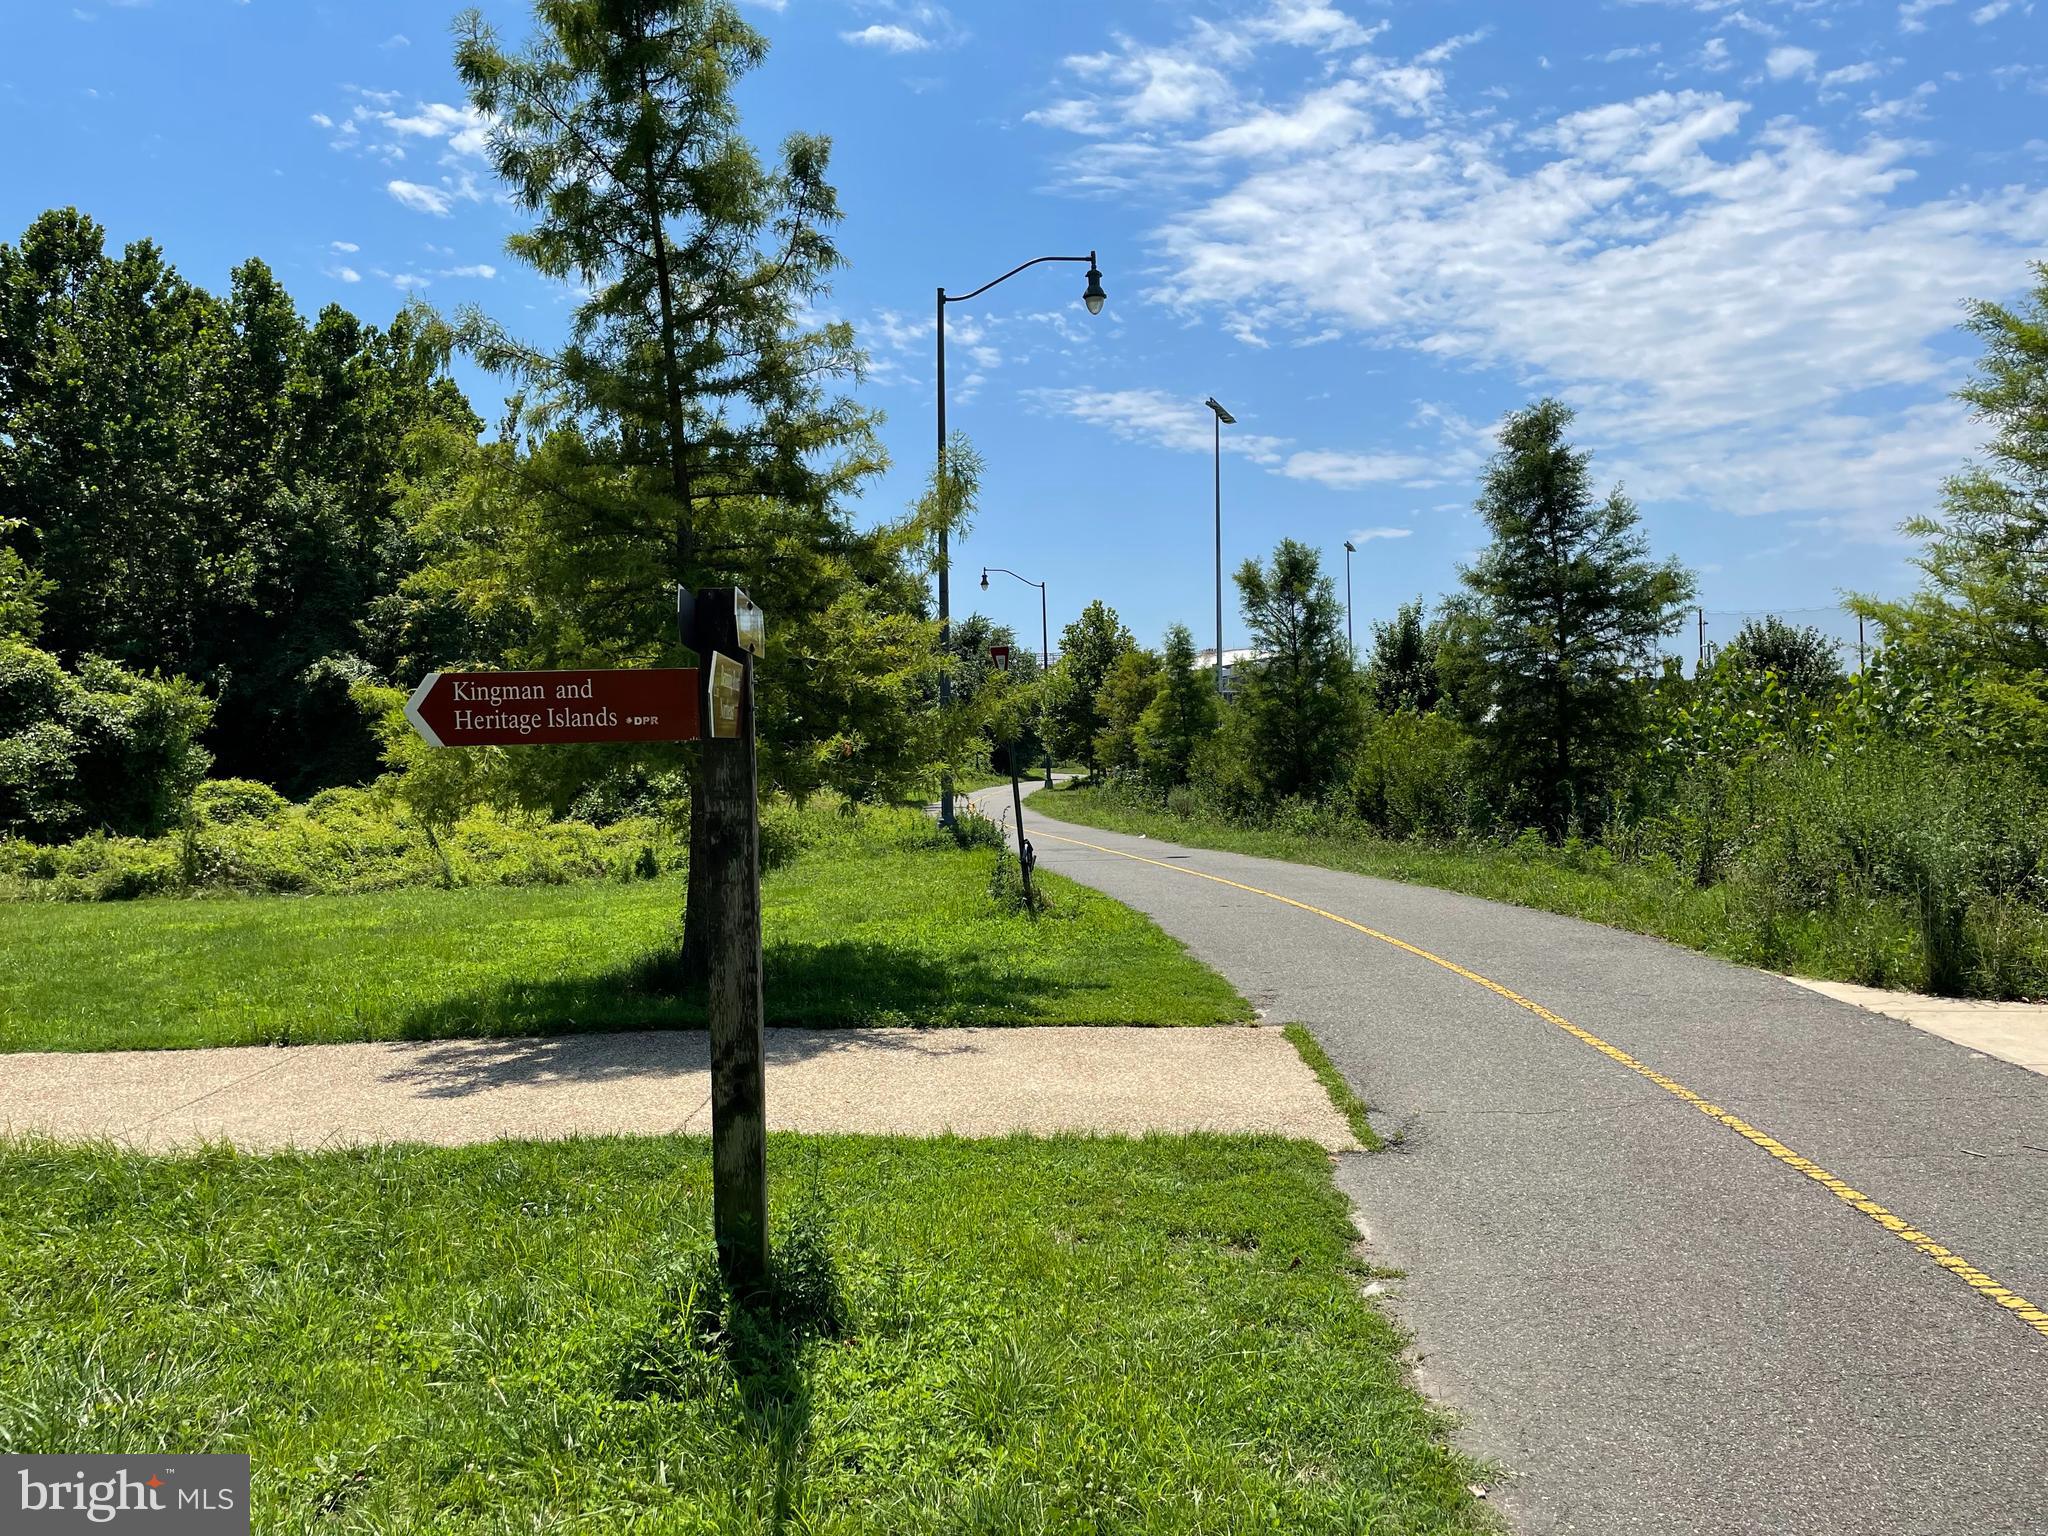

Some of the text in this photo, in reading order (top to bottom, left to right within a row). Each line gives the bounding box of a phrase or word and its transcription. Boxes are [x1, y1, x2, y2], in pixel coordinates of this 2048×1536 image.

[453, 679, 593, 706] Kingman and
[454, 707, 618, 734] Heritage Islands
[634, 716, 659, 726] DPR
